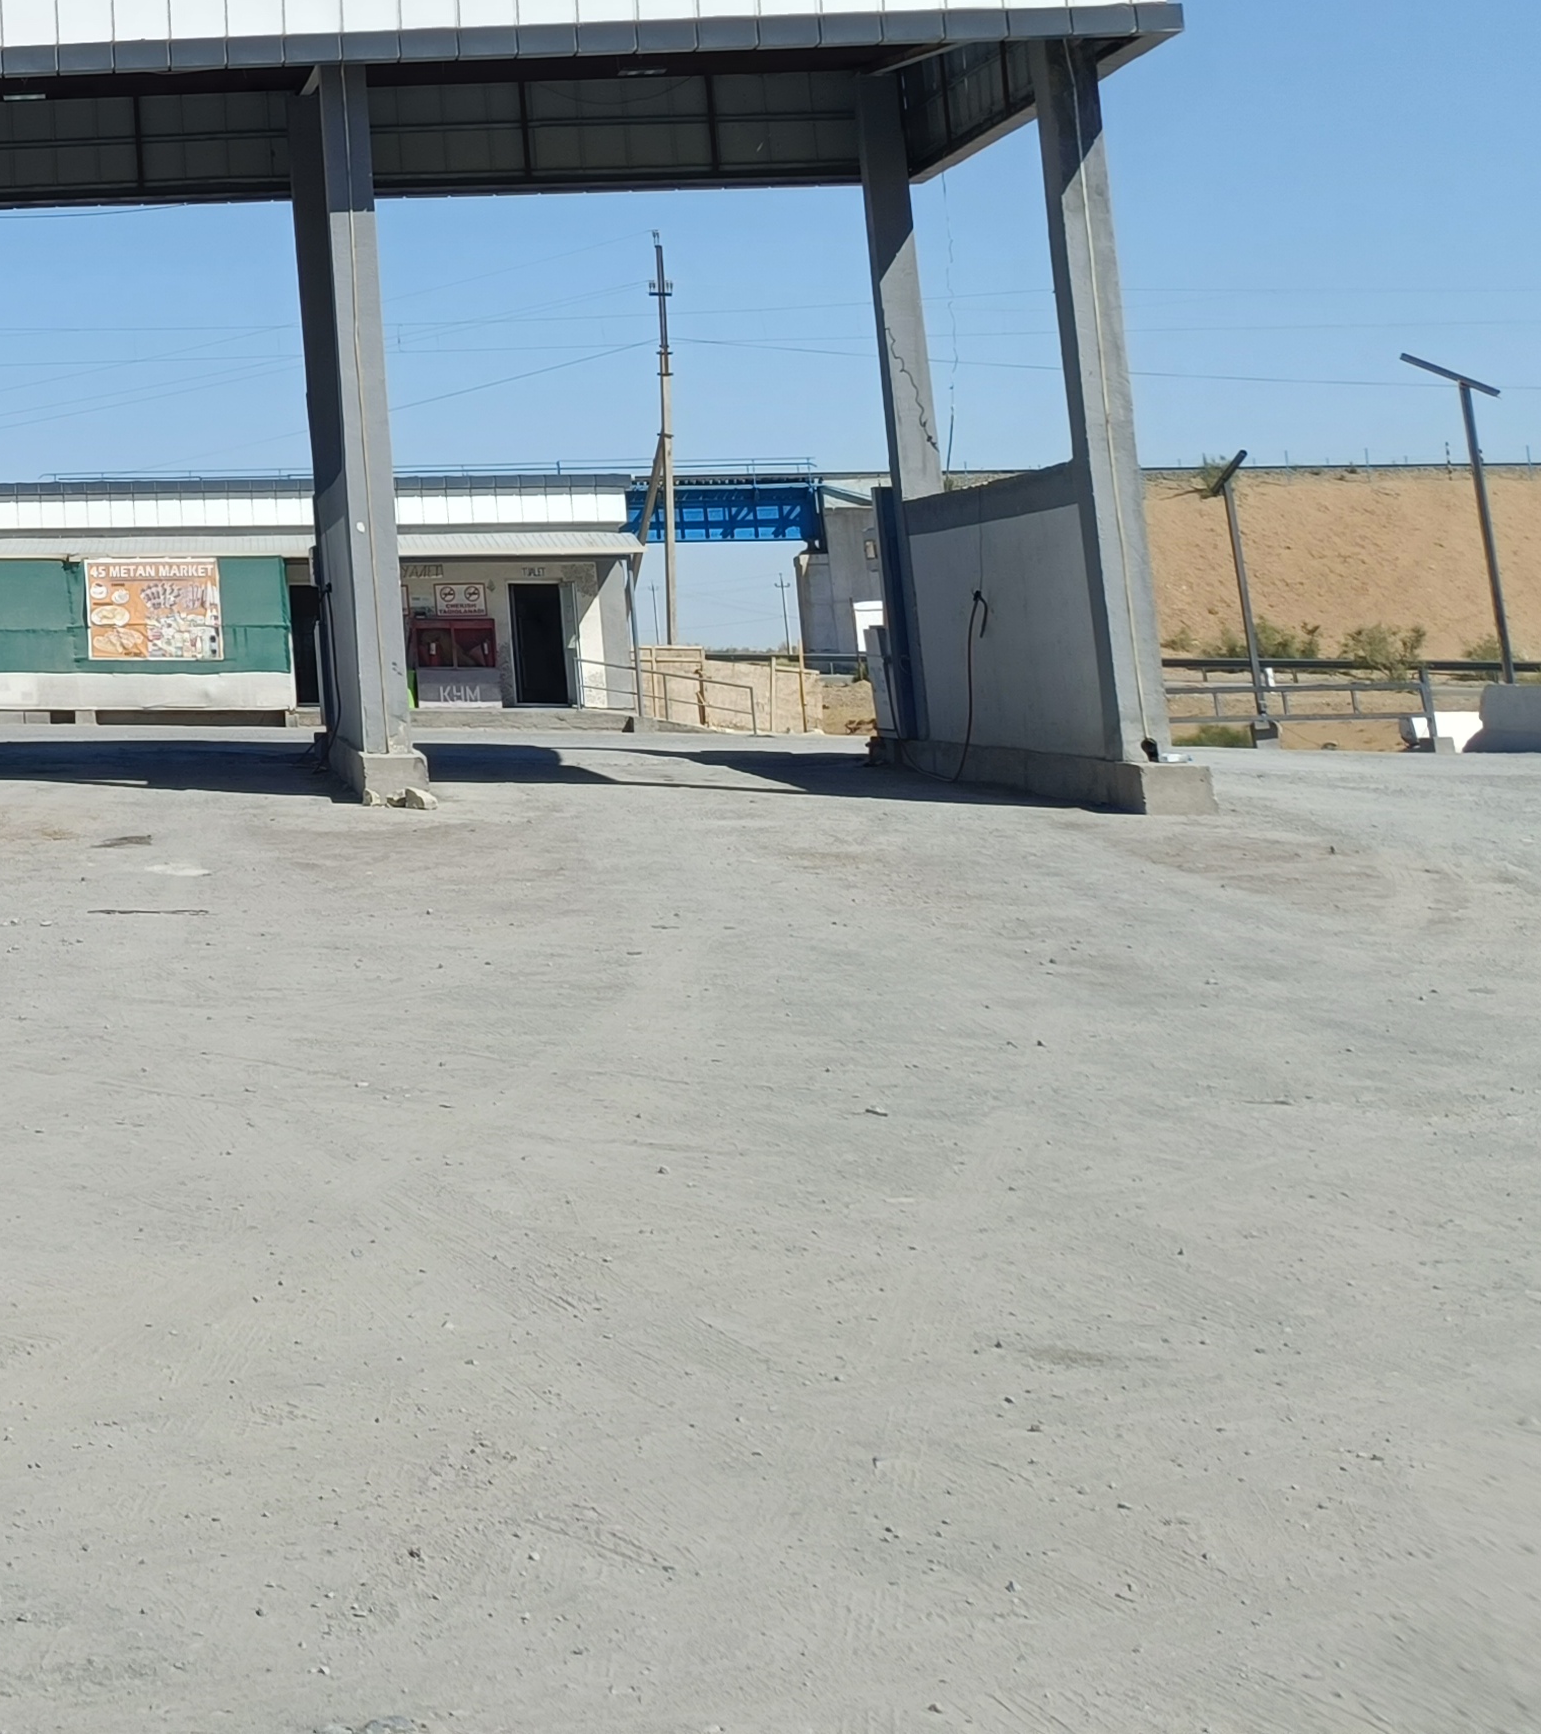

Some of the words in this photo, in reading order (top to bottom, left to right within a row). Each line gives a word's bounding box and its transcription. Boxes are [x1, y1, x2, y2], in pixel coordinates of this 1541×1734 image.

[90, 565, 107, 578] 45
[109, 564, 156, 578] METAN
[158, 563, 214, 577] MARKET
